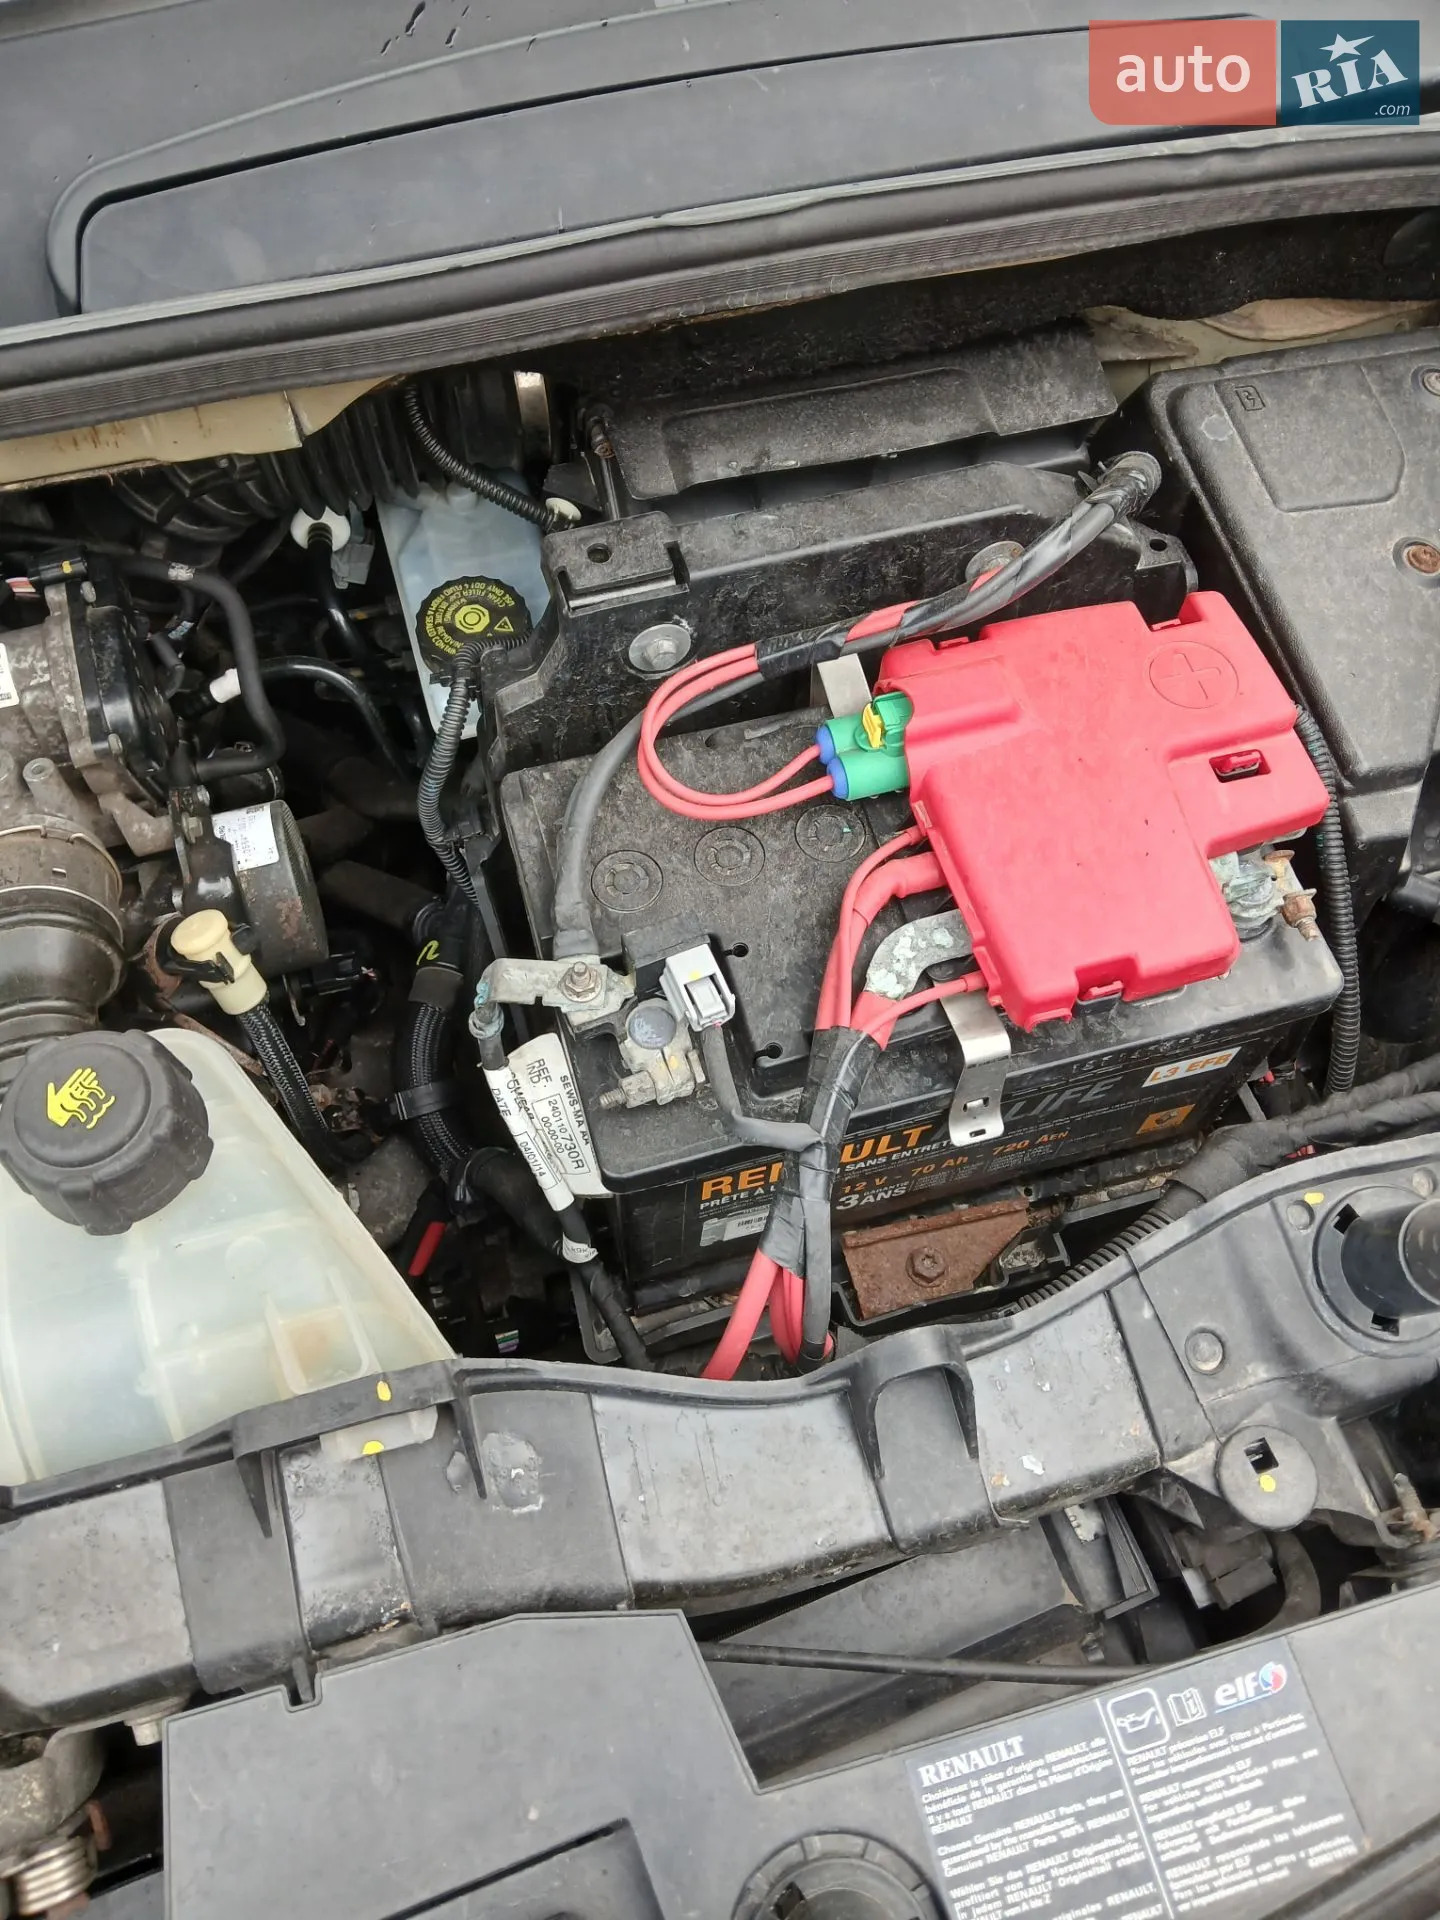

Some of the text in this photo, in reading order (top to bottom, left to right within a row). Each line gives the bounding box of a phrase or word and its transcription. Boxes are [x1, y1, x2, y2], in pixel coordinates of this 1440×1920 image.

[436, 626, 464, 649] REMOVIN
[533, 1058, 552, 1088] REF.
[1150, 1054, 1232, 1082] L3 EFB
[491, 1087, 512, 1118] DATE
[1004, 1076, 1122, 1120] LIFE
[541, 1116, 565, 1154] 00-00-00
[520, 1140, 546, 1178] 04/01/14
[842, 1182, 868, 1194] 12
[875, 1176, 888, 1186] V
[912, 1164, 936, 1176] 70
[941, 1156, 968, 1168] Ah
[992, 1140, 1030, 1156] 720
[845, 1156, 887, 1172] SANS
[836, 1186, 908, 1210] 3 ANS
[1214, 1672, 1258, 1706] elf
[918, 1736, 1024, 1787] RENAULT
